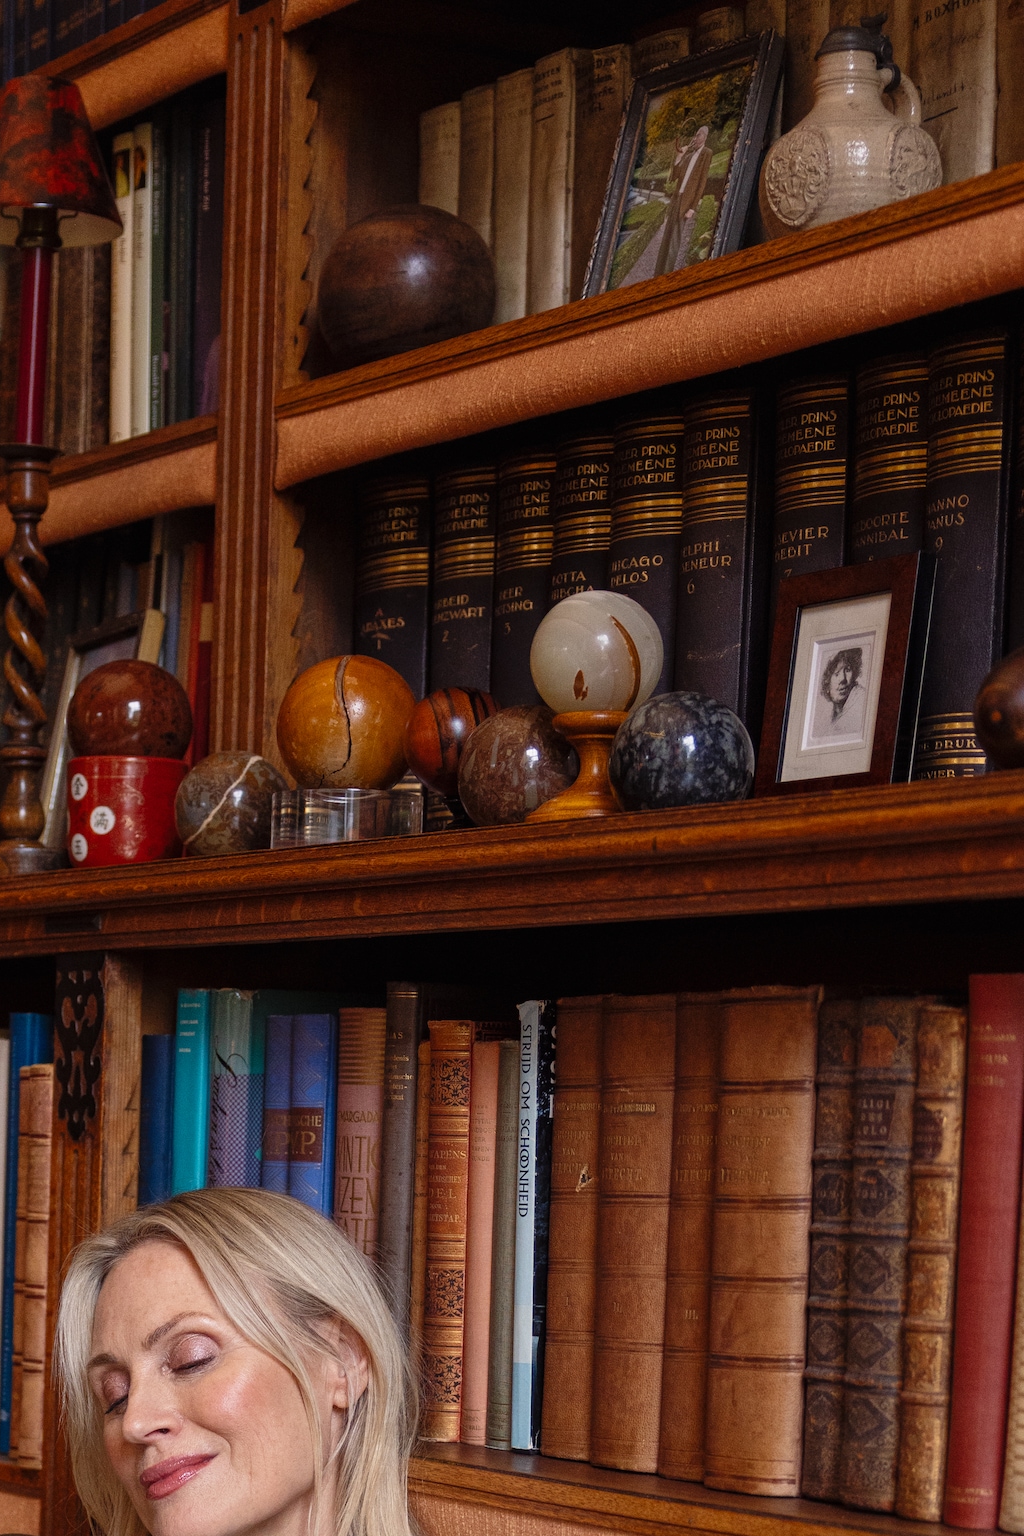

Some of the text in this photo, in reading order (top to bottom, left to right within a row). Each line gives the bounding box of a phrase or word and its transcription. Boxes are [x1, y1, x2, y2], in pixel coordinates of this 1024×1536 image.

[956, 368, 995, 386] PRINS
[883, 390, 920, 406] PRINS
[801, 410, 837, 426] PRINS
[705, 425, 740, 441] PRINS
[641, 443, 676, 457] PRINS
[576, 462, 609, 476] PRINS
[519, 479, 550, 493] PRINS
[459, 490, 490, 505] PRINS
[935, 536, 943, 552] 9
[686, 578, 695, 594] 6
[441, 630, 450, 643] 2
[935, 738, 977, 749] DRUK
[518, 1024, 533, 1219] STRIJD OM SCHOONHEID
[611, 1152, 624, 1161] VAN
